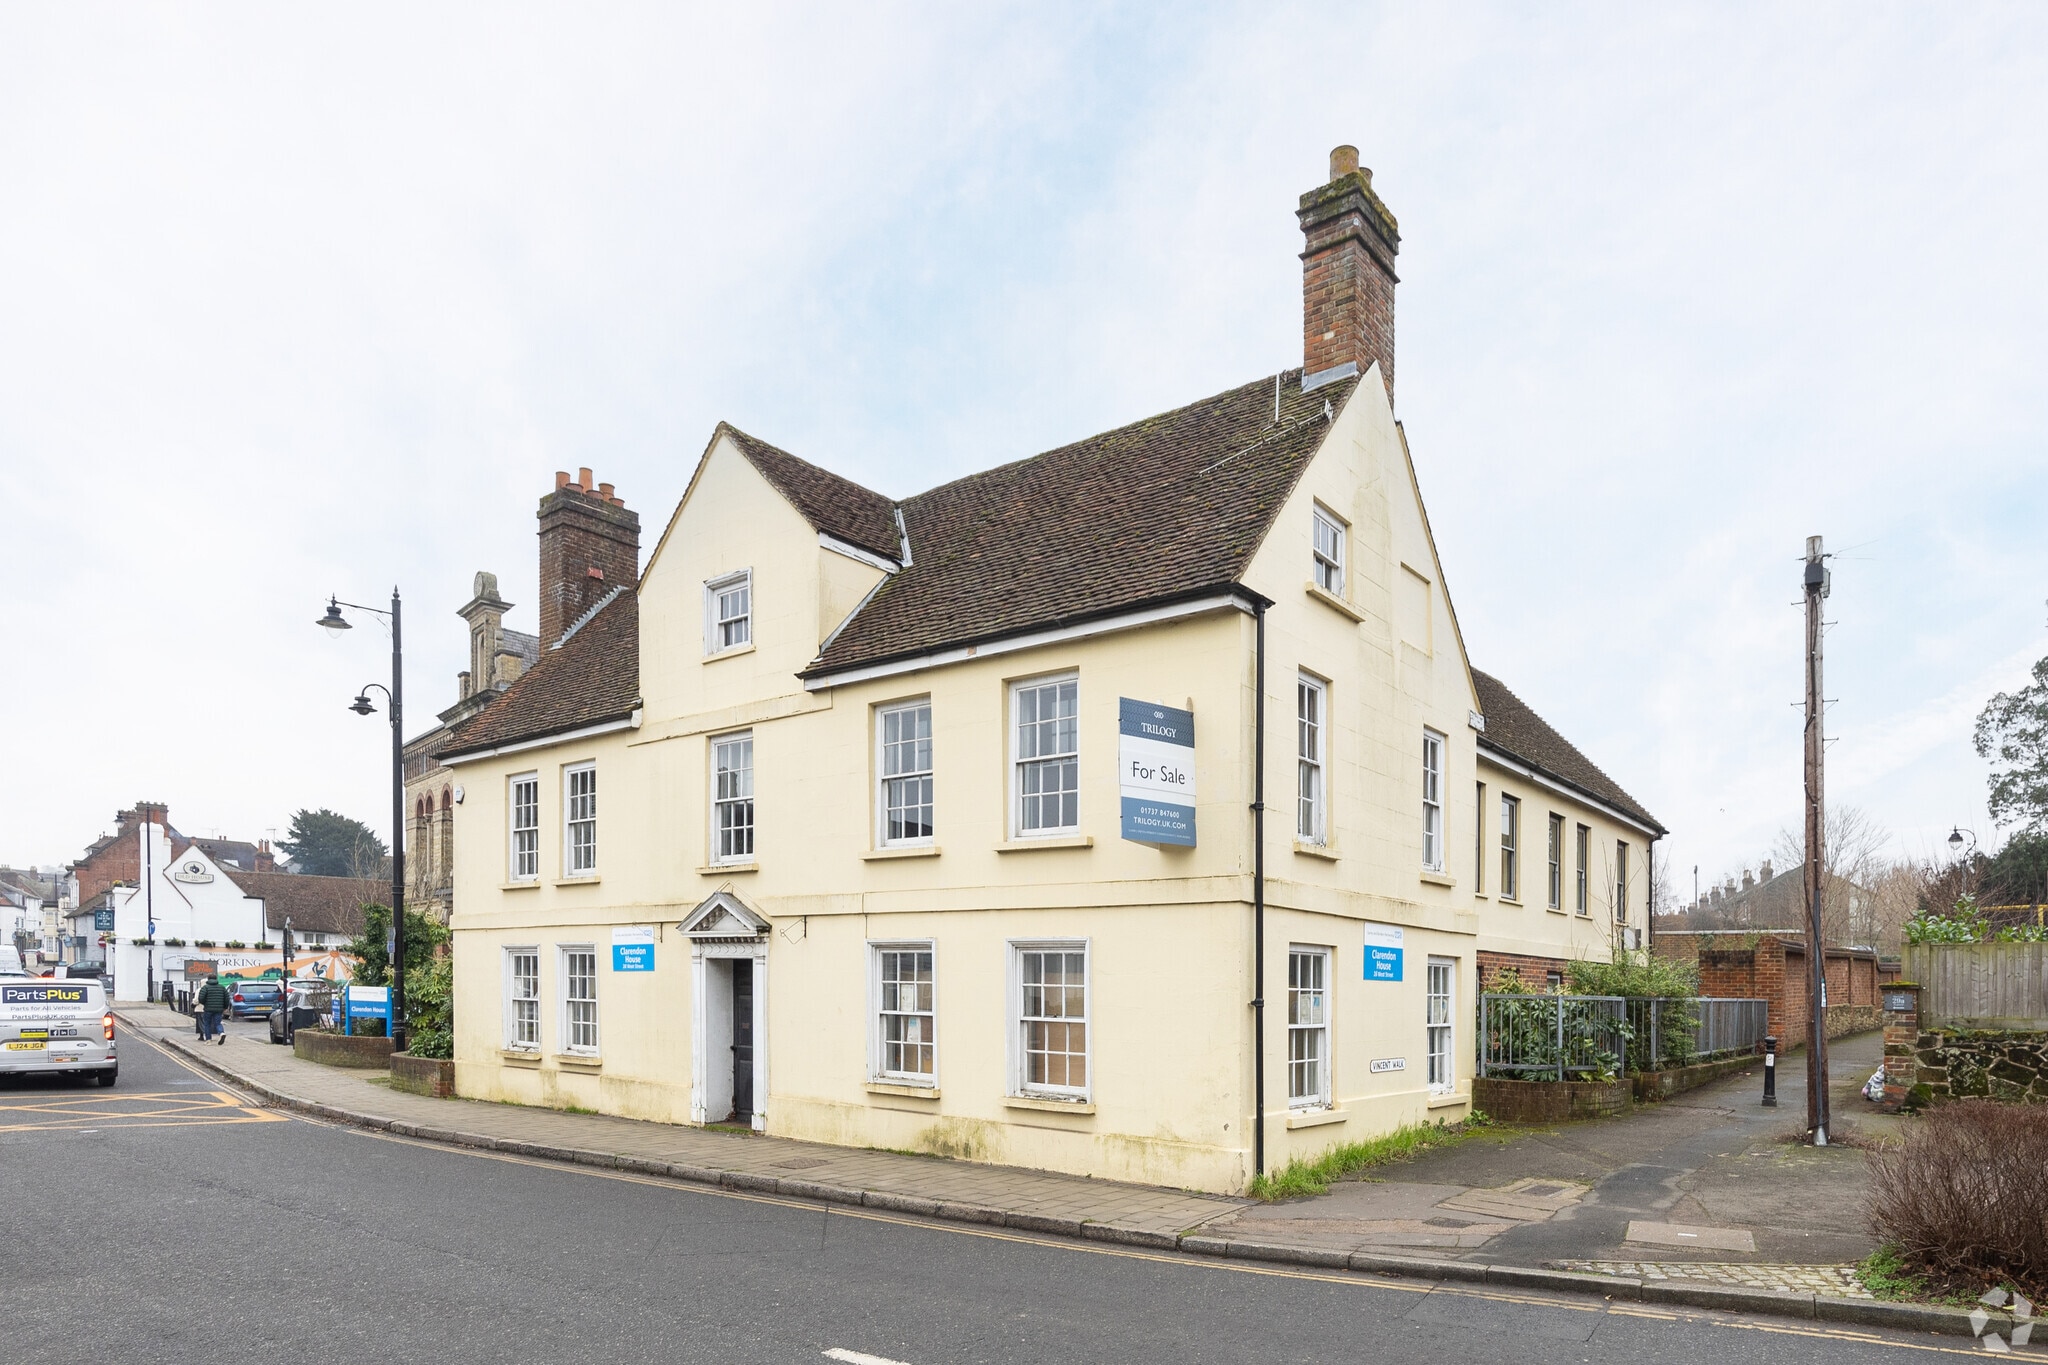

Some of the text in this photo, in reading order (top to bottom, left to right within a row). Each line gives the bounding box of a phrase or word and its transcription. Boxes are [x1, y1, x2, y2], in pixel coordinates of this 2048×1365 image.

[1141, 722, 1177, 738] TRILOGY
[1132, 761, 1186, 785] For Sale
[1141, 807, 1180, 819] 01737 847600
[1134, 817, 1186, 829] TRILOGY.UK.COM
[620, 947, 646, 955] Clarendon
[1371, 949, 1396, 960] Clarendon
[211, 958, 262, 967] ORKING
[625, 955, 641, 963] House
[1376, 961, 1391, 970] House
[6, 989, 80, 1001] PartsPlus
[1373, 1060, 1404, 1070] VINCENT WALK
